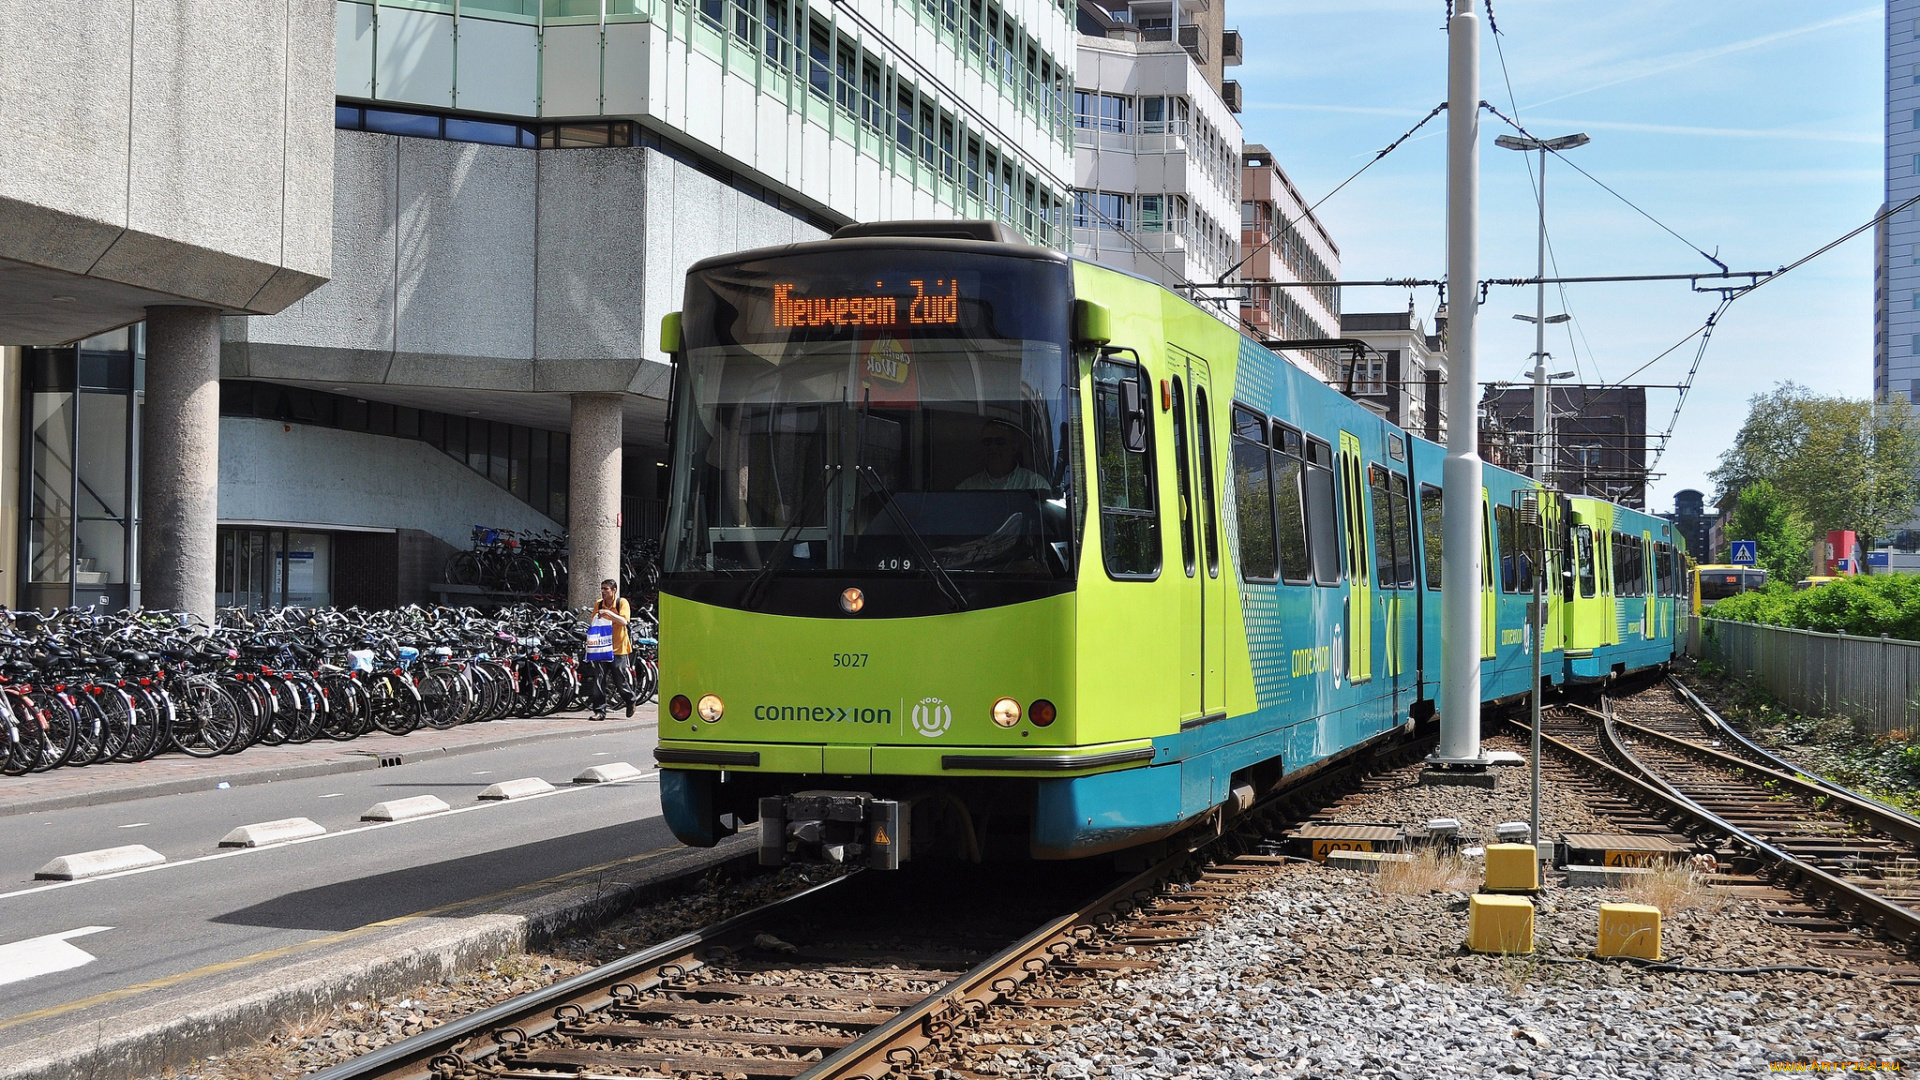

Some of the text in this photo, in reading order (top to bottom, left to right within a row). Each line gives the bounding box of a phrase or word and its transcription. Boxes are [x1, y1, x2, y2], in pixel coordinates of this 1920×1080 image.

[773, 278, 958, 328] Nieuwegein Zuid
[878, 559, 911, 570] 409
[833, 653, 869, 668] 5027
[754, 704, 892, 724] connexxion
